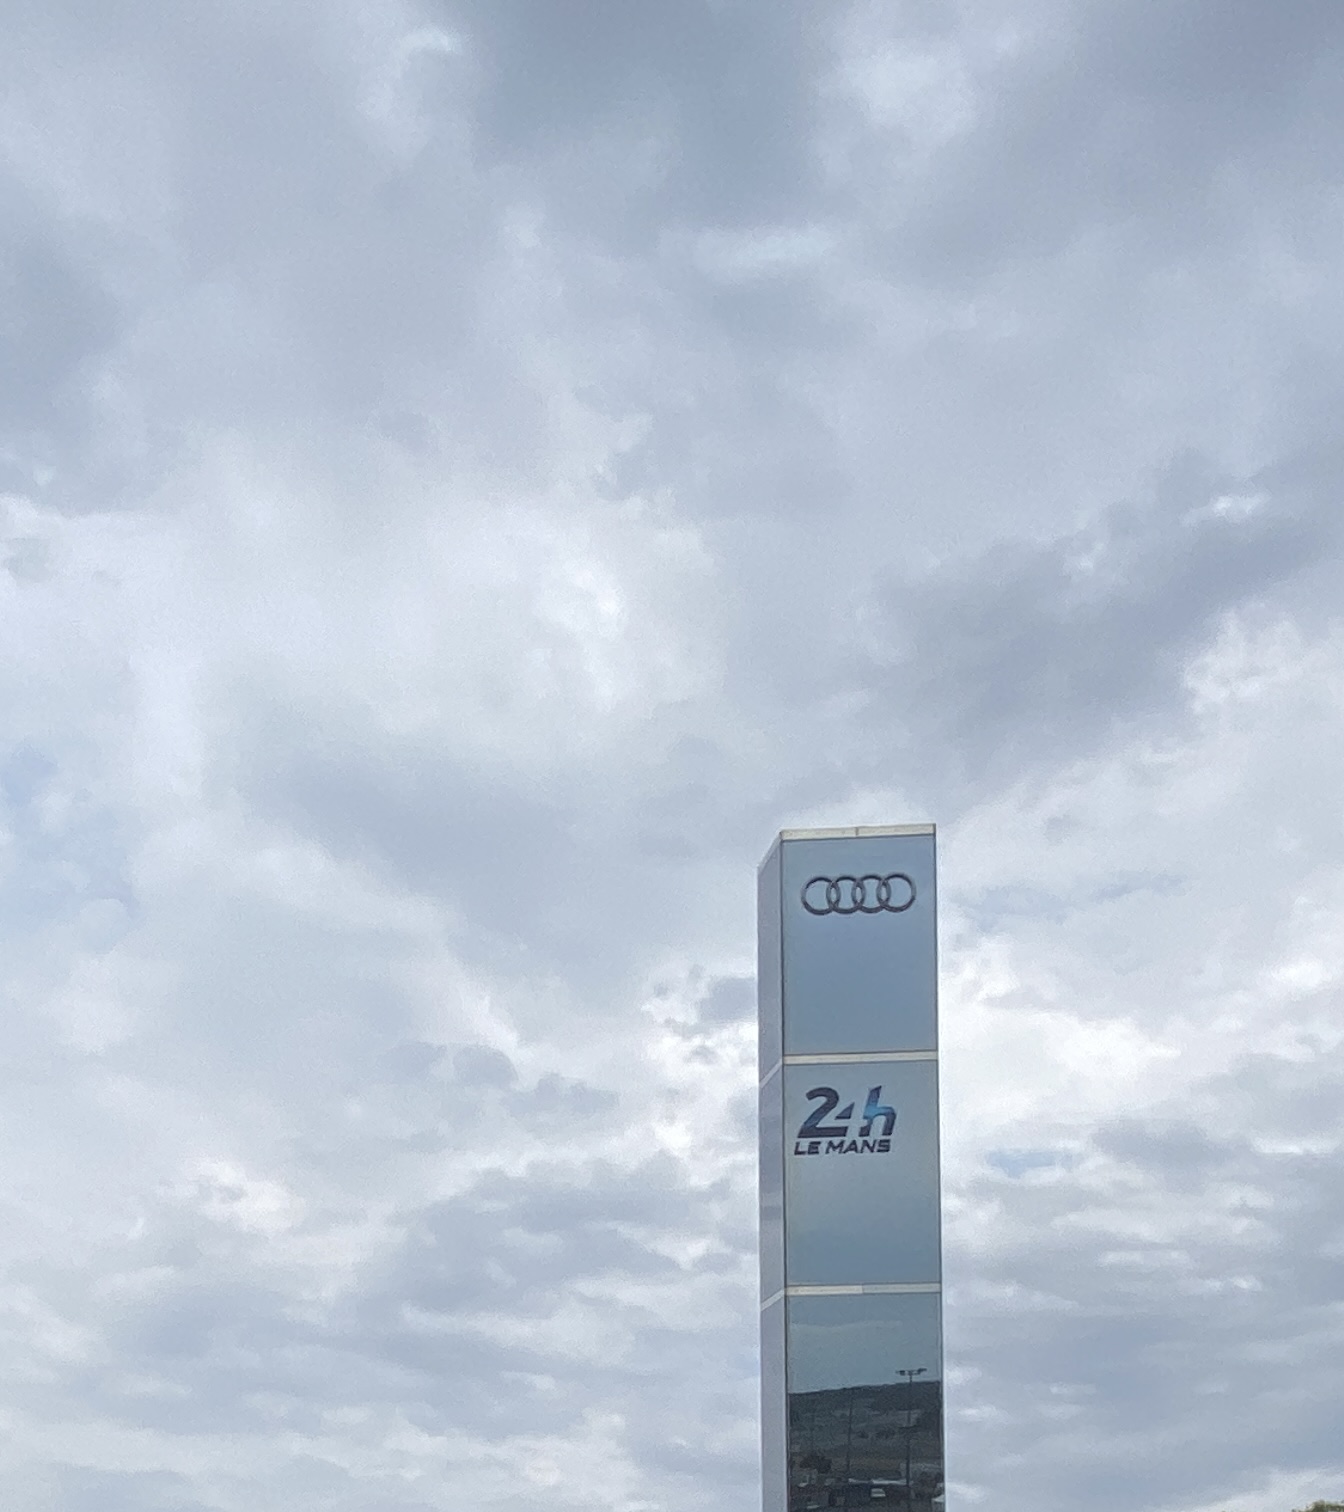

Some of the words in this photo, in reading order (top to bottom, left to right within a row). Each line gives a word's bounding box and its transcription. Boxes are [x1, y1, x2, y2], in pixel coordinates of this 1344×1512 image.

[797, 1085, 896, 1138] 24h
[794, 1141, 821, 1155] LE
[825, 1139, 891, 1154] MANS
